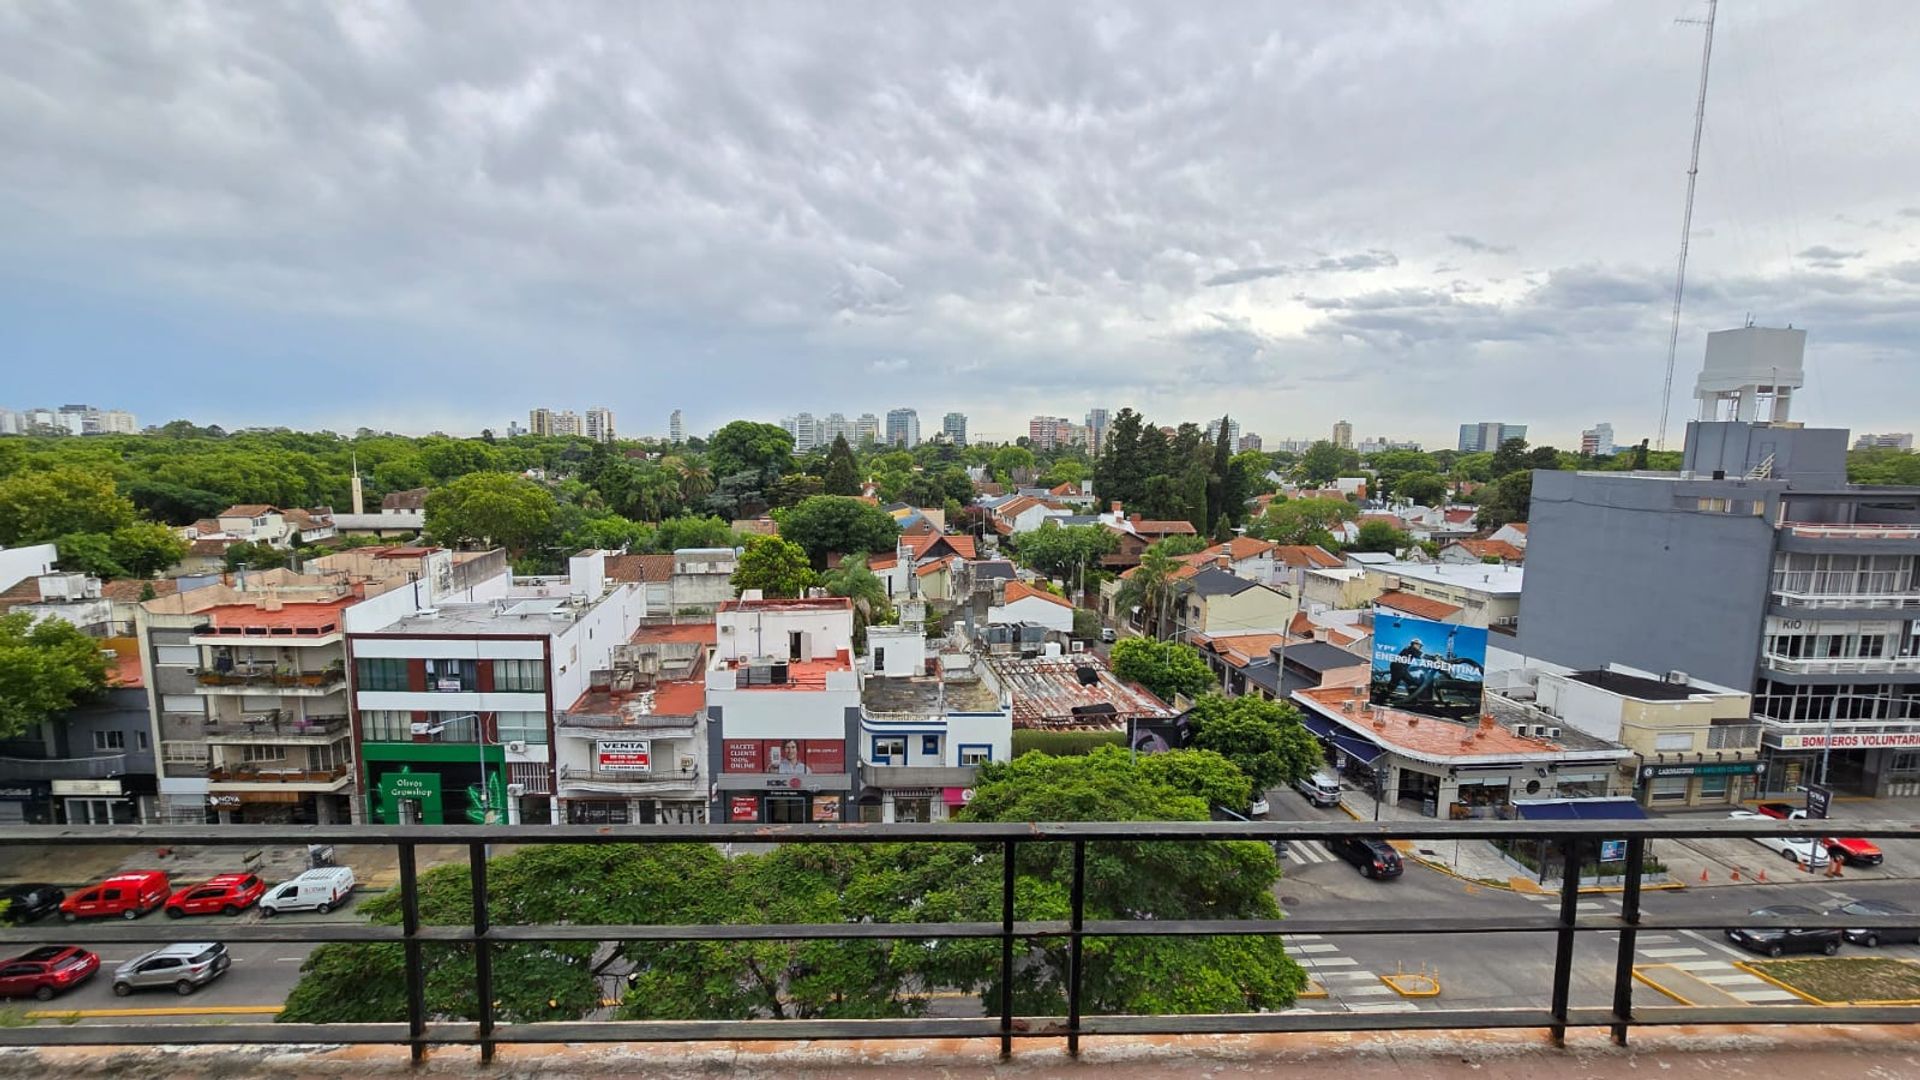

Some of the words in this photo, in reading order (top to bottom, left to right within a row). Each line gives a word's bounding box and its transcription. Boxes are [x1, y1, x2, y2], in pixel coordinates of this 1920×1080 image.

[1376, 643, 1397, 652] YPF
[1375, 651, 1416, 665] ENERGÍA
[1419, 659, 1480, 676] ARGENTINA
[1861, 734, 1920, 746] VOLUNTARI
[396, 779, 422, 787] Olivos
